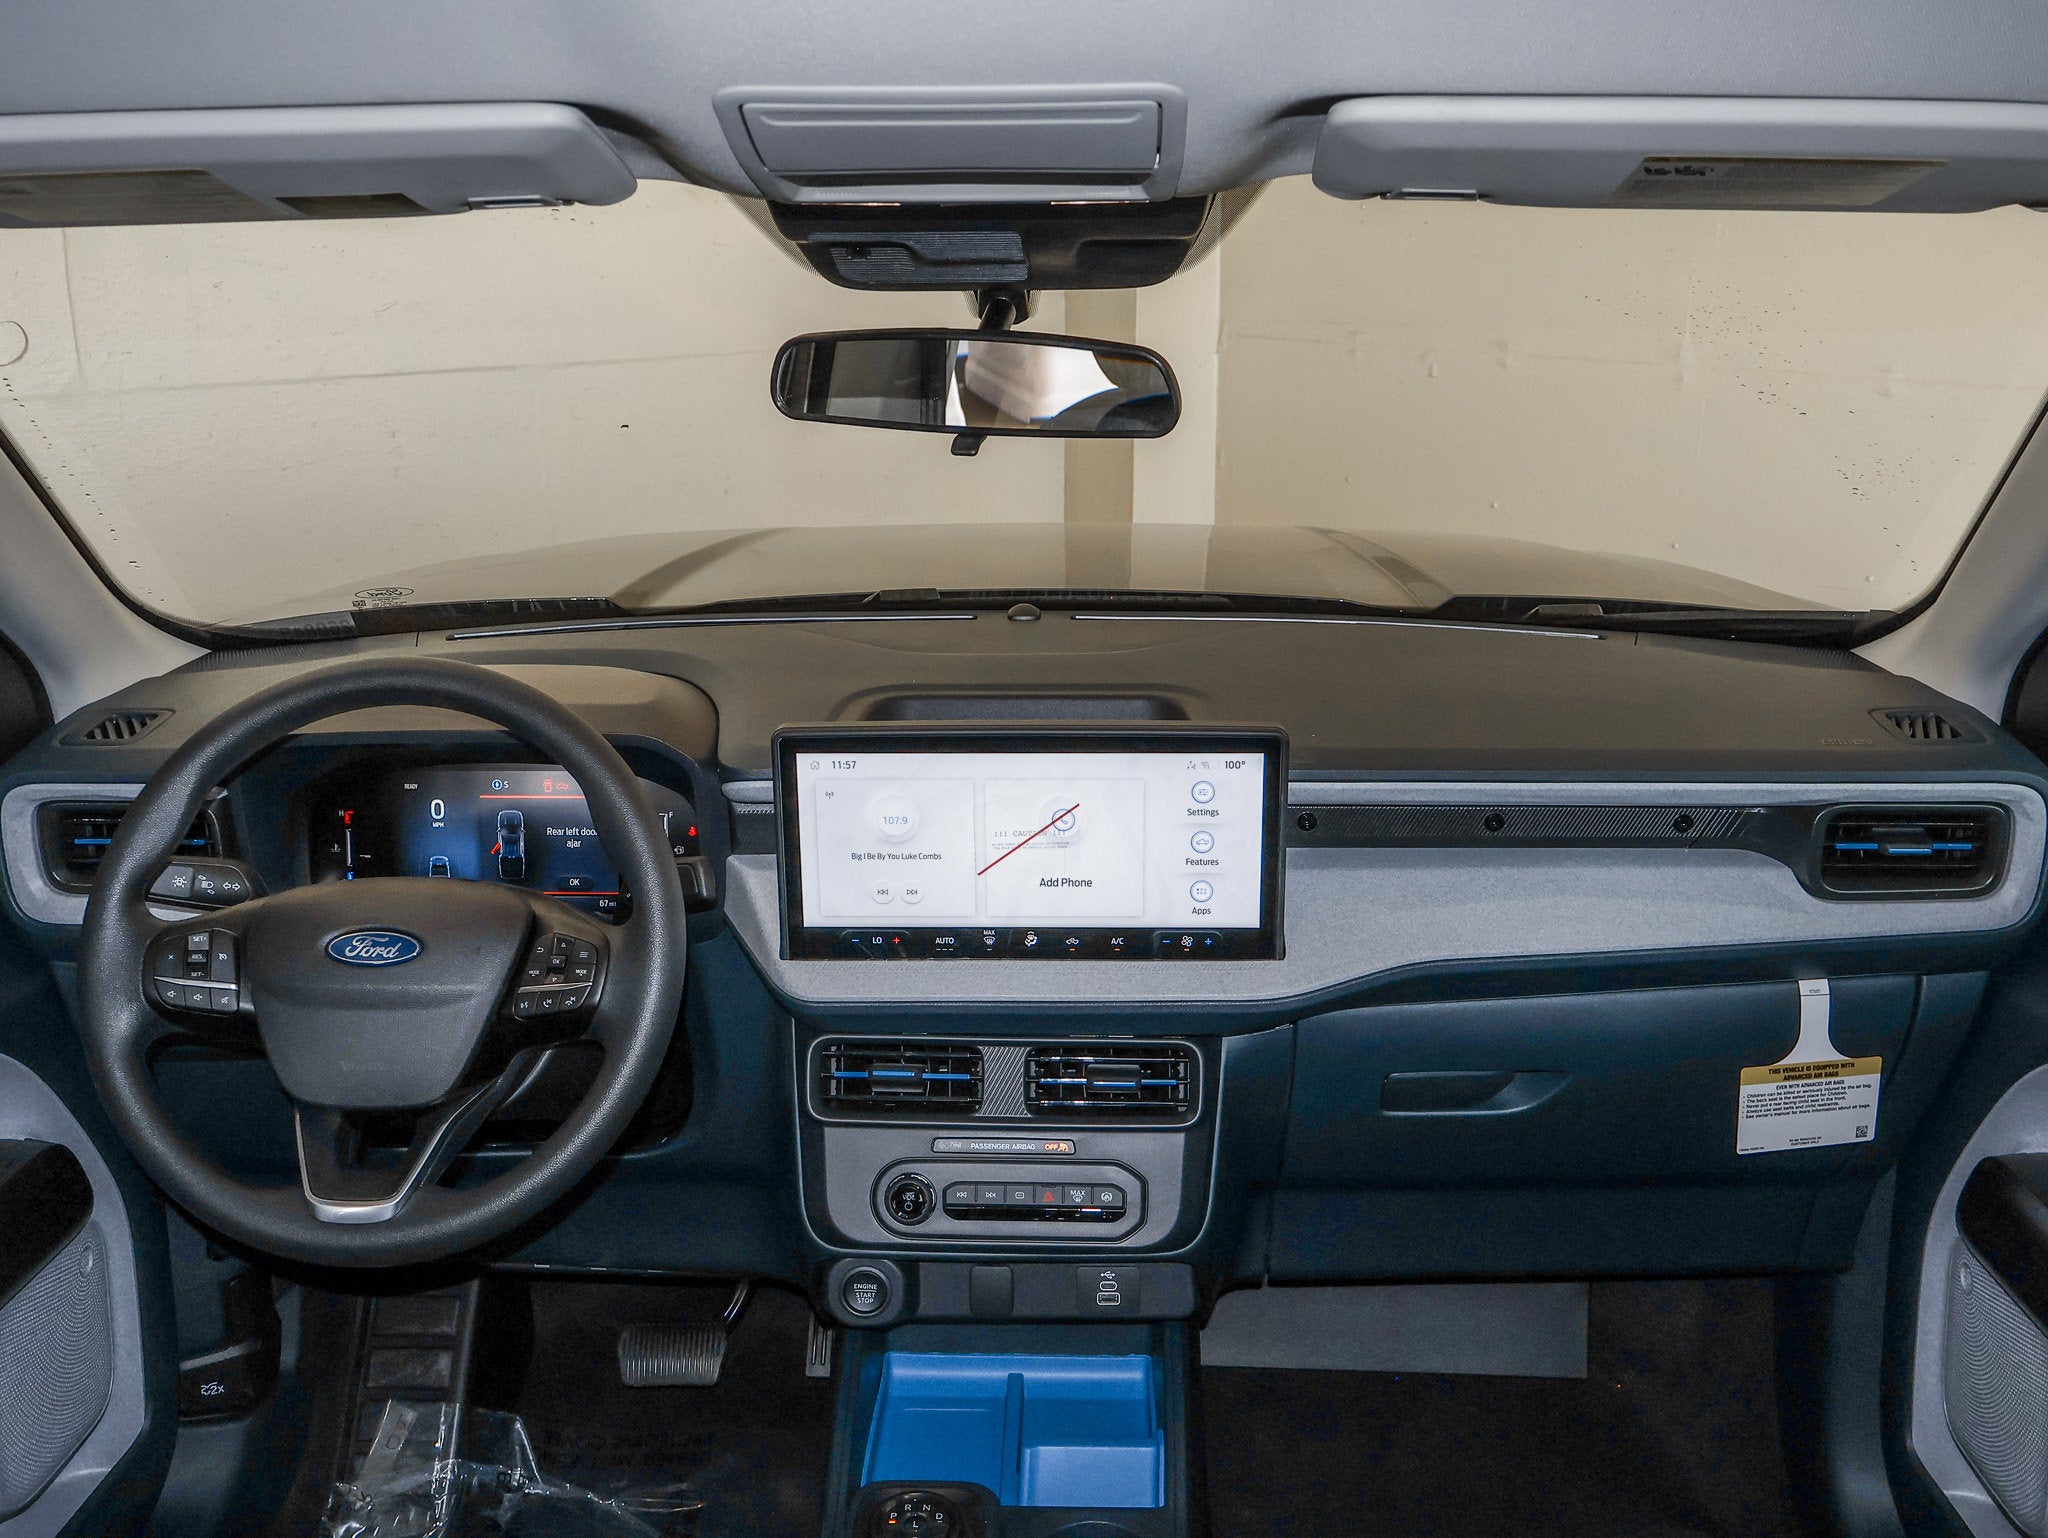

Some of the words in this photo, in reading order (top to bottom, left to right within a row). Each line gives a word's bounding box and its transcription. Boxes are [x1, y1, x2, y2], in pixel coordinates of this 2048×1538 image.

[832, 761, 856, 769] 11:57
[1225, 760, 1246, 769] 100°
[430, 799, 445, 820] 0
[1187, 808, 1220, 817] Settings
[883, 816, 908, 825] 107.9
[547, 827, 565, 836] Rear
[566, 827, 579, 836] left
[581, 827, 598, 836] doo
[566, 839, 581, 848] ajar
[851, 853, 863, 861] Big
[1185, 858, 1219, 866] Features
[1040, 878, 1058, 887] Add
[1061, 878, 1092, 887] Phone
[1192, 907, 1211, 915] Apps
[345, 936, 402, 959] Ford
